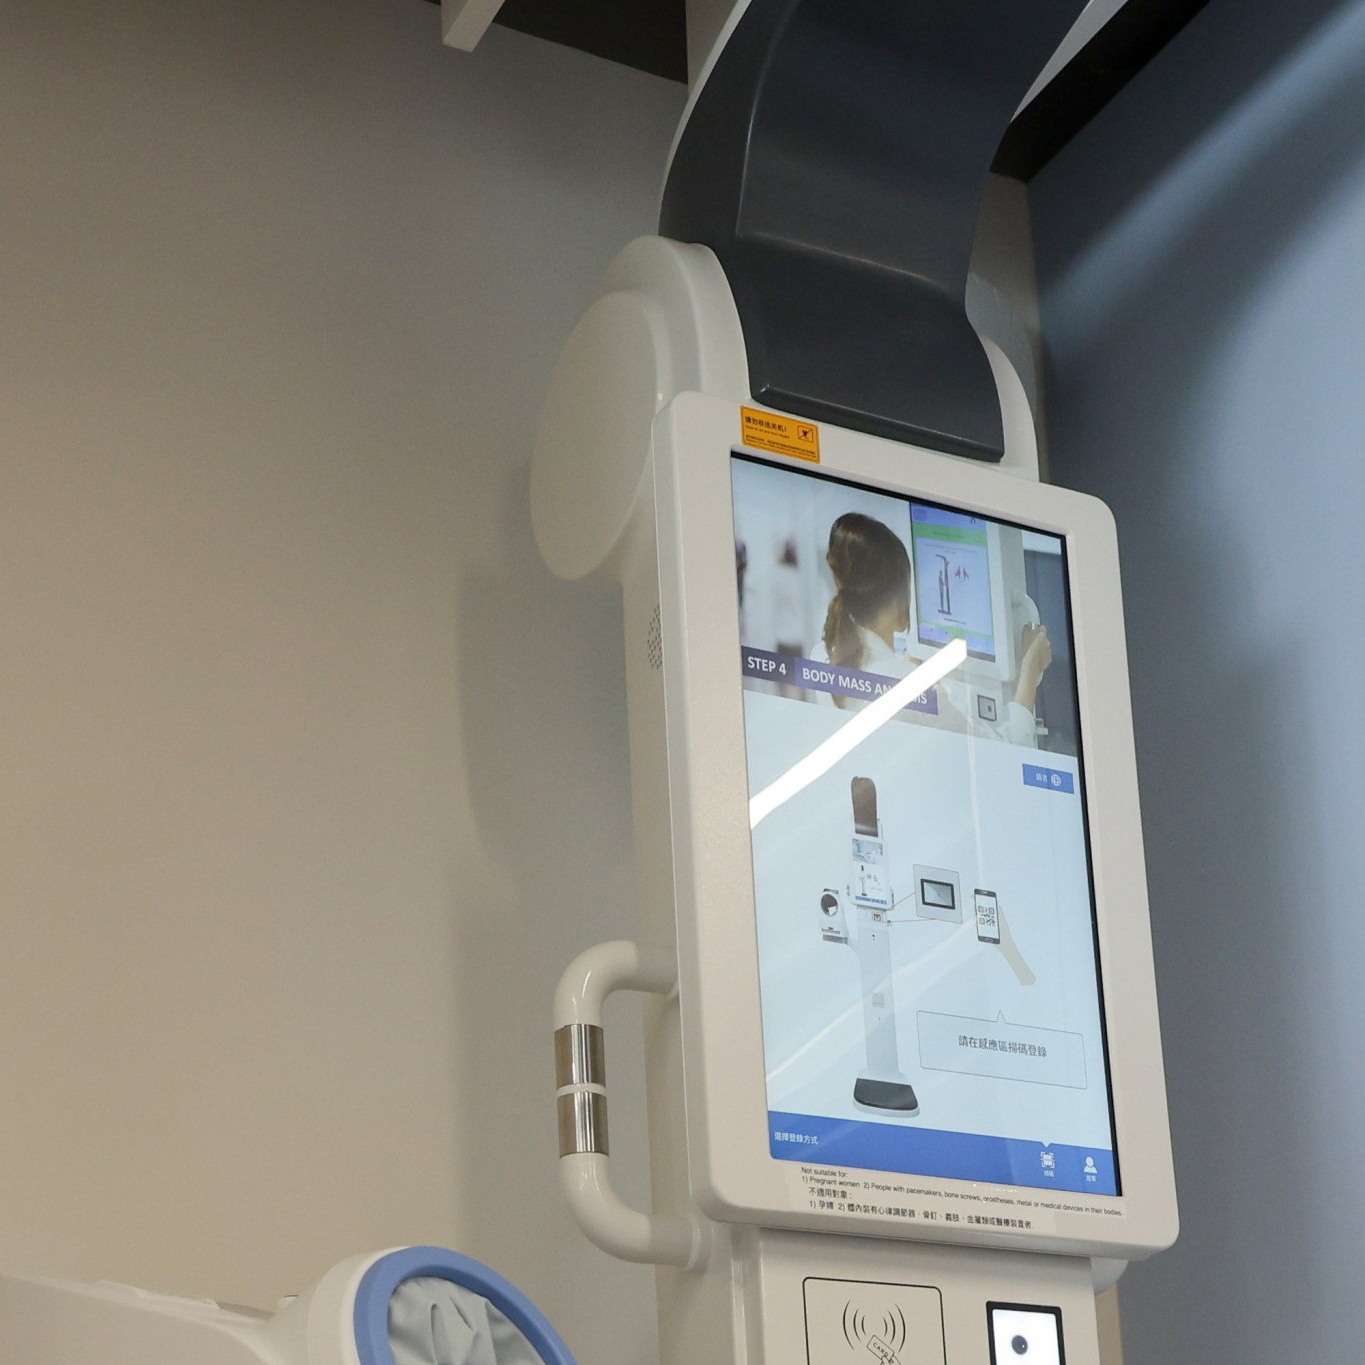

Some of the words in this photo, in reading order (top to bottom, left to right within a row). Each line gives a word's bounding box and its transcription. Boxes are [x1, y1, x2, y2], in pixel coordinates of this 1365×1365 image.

[747, 655, 776, 673] STEP
[778, 662, 787, 675] 4
[802, 667, 835, 685] BODY
[838, 674, 872, 693] MASS
[814, 1168, 837, 1177] suitable
[802, 1176, 808, 1184] 1)
[809, 1177, 837, 1186] Pregnant
[863, 1182, 870, 1190] 2)
[871, 1183, 892, 1192] People
[893, 1185, 905, 1193] with
[906, 1187, 944, 1197] pacemakers,
[945, 1190, 959, 1198] bone
[1040, 1201, 1062, 1210] medical
[1063, 1204, 1084, 1212] devices
[1091, 1206, 1103, 1214] their
